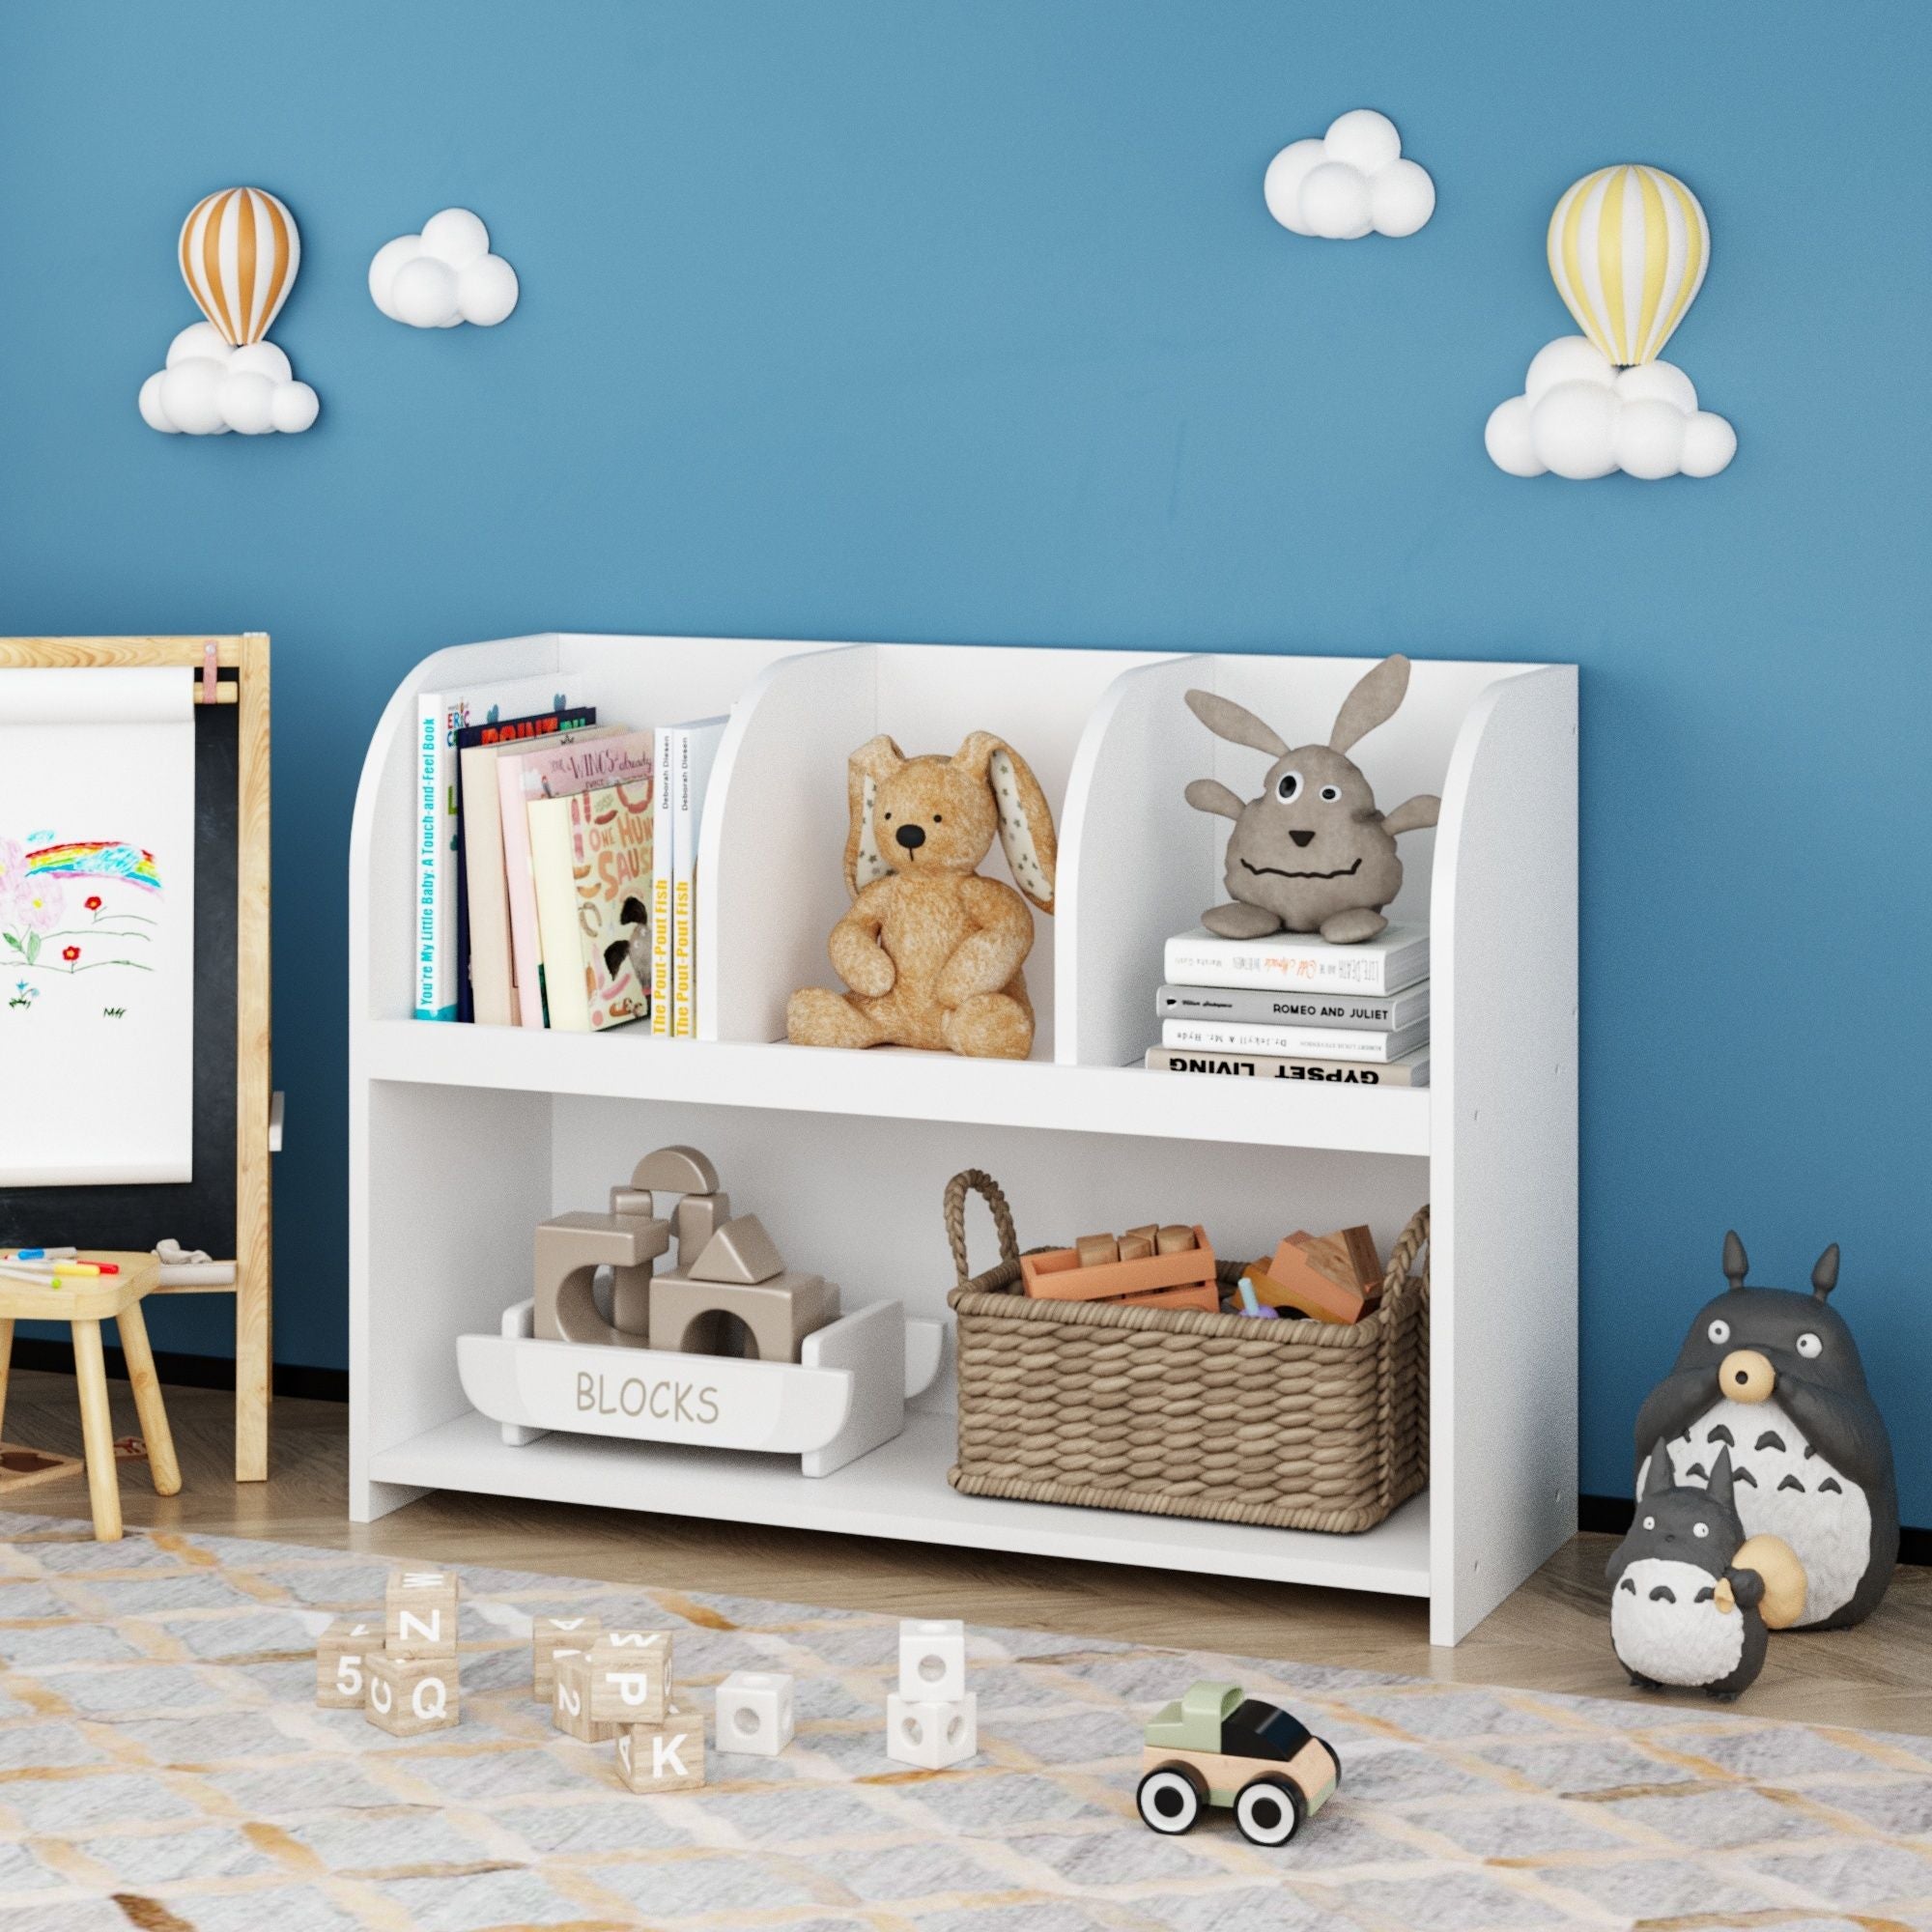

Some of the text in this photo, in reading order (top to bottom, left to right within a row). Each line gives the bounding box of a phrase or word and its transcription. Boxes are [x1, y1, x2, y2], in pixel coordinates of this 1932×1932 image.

[661, 736, 670, 810] Deborah Diesen
[590, 812, 654, 852] ONE HUN
[419, 718, 435, 1006] You're My Little Baby: A Touch-and-Feel Book
[598, 845, 654, 902] SAUS
[653, 879, 668, 1035] The Pout-Pout Fish
[675, 881, 690, 1037] The Pout-Pout Fish
[1273, 1003, 1389, 1020] ROMEO AND JULIET
[1169, 1058, 1379, 1085] GYPSET LIVING
[577, 1372, 719, 1424] BLOCKS
[399, 1608, 440, 1642] N
[336, 1656, 362, 1695] 5
[606, 1673, 647, 1706] P
[412, 1677, 446, 1719] Q
[652, 1733, 689, 1778] K
